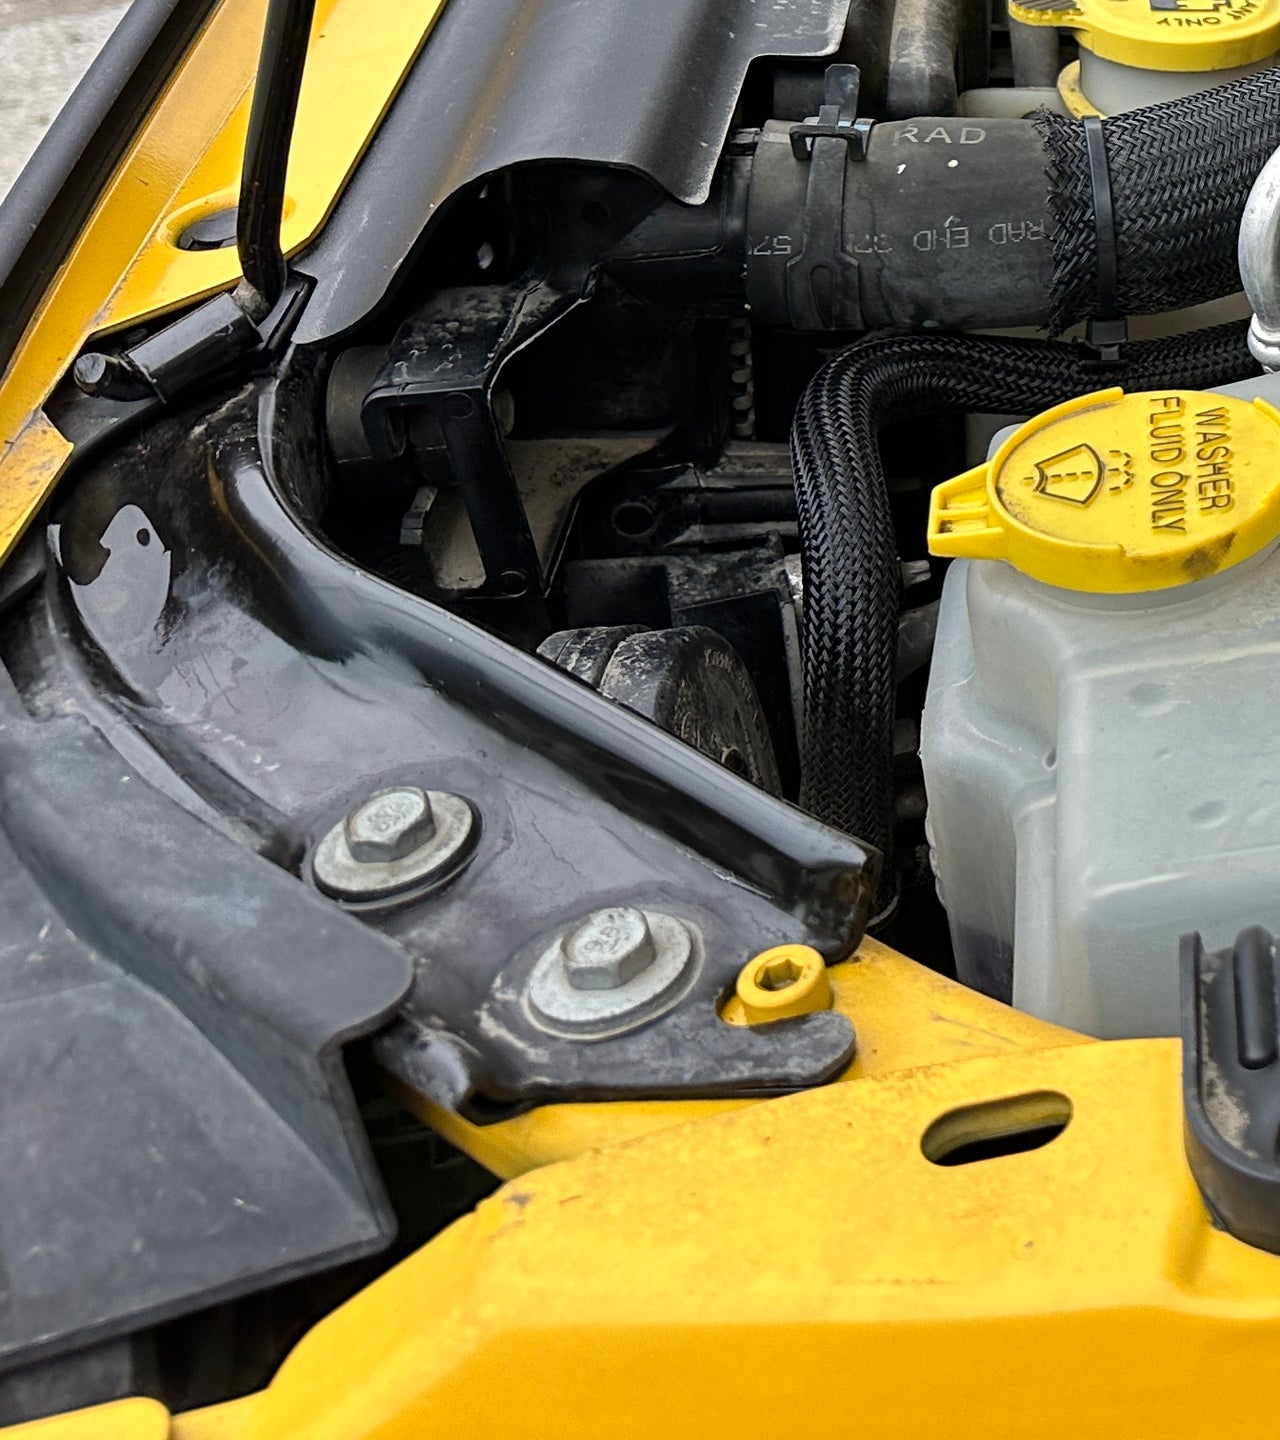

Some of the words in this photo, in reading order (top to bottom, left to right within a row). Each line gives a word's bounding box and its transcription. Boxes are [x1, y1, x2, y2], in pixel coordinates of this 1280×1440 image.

[1156, 16, 1222, 28] ONLY
[893, 125, 987, 146] RAD
[988, 219, 1046, 244] RAD
[1149, 396, 1184, 465] FLUID
[1194, 405, 1235, 518] WASHER
[1149, 470, 1187, 535] ONLY
